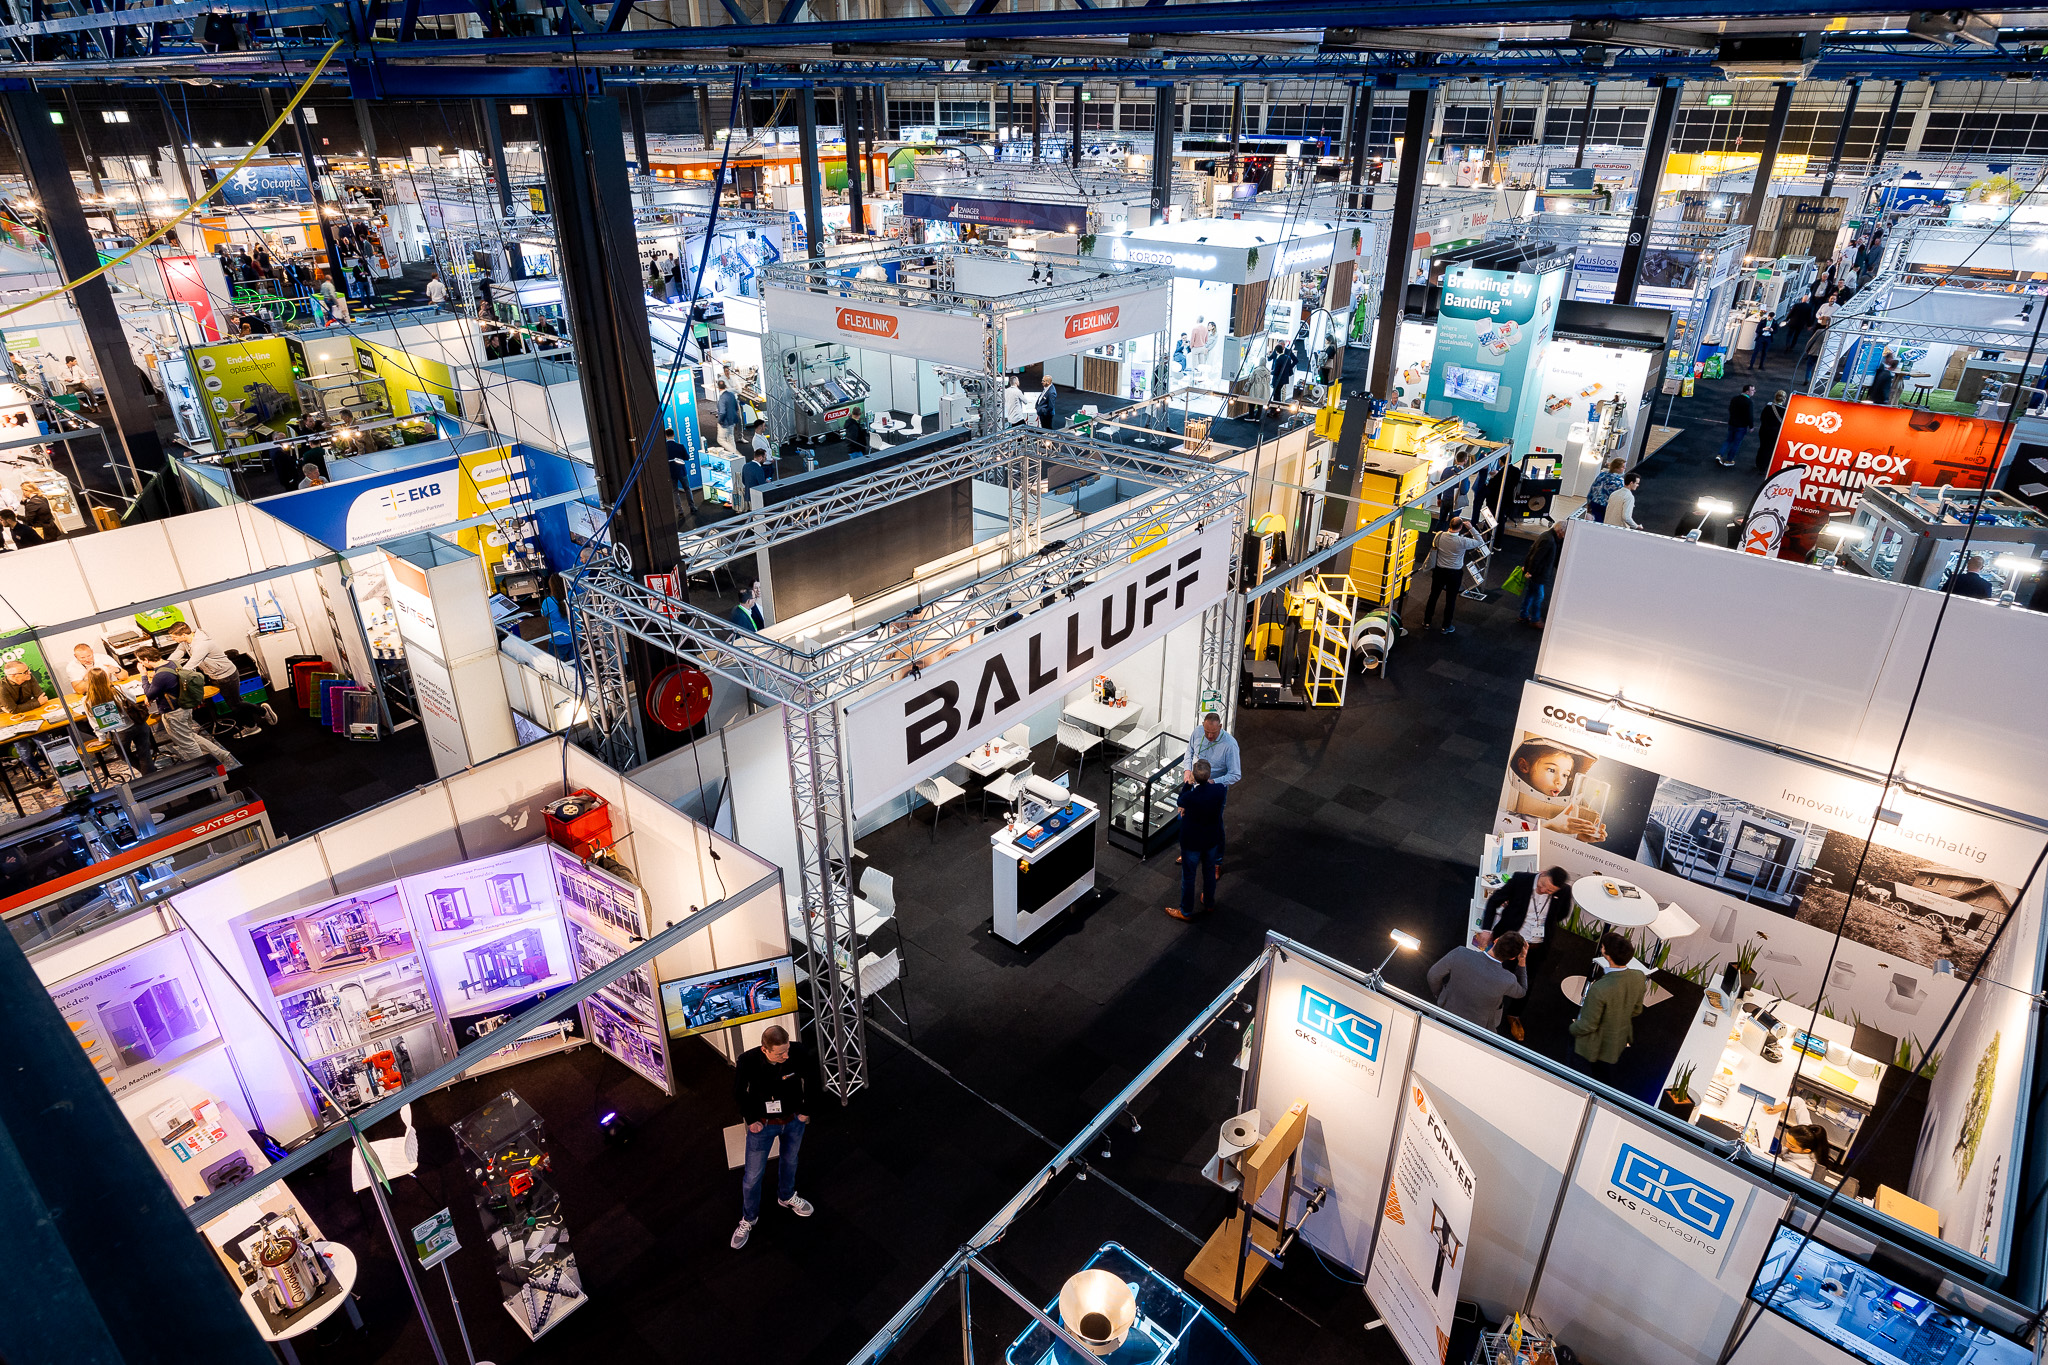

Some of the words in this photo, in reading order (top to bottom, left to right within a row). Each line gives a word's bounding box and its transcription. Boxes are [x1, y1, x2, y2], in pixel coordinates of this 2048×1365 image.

[261, 178, 301, 191] Octopus
[959, 206, 979, 215] ZWAGER
[1471, 211, 1489, 227] Weber
[1129, 250, 1173, 265] KOROZO
[1578, 254, 1618, 266] Ausloos
[1447, 273, 1510, 297] Branding
[1513, 279, 1533, 299] by
[844, 313, 889, 332] FLEXLINK
[1072, 313, 1112, 333] FLEXLINK
[1441, 324, 1458, 332] Where
[1438, 338, 1474, 349] sustainability
[1439, 332, 1457, 340] design
[226, 352, 271, 366] End-of-line
[229, 361, 277, 375] oplossingen
[827, 408, 848, 422] FLEXLINK
[684, 416, 695, 462] ingenious
[1787, 440, 1855, 467] YOUR
[1855, 452, 1912, 476] BOX
[690, 463, 697, 476] Be
[408, 482, 441, 502] EKB
[397, 508, 427, 520] Integration
[426, 502, 445, 512] Partner
[904, 547, 1202, 765] BALLUFF
[1541, 717, 1564, 729] DRUCK
[1633, 746, 1648, 756] 1833
[191, 809, 249, 835] BATEQ
[1781, 788, 1854, 821] Innovativ
[1893, 824, 1988, 864] nachhaltig
[52, 979, 94, 1001] Processing
[94, 964, 127, 983] Machine
[1301, 990, 1377, 1056] GKS
[1295, 1028, 1318, 1045] GKS
[1319, 1041, 1376, 1077] Packaging
[128, 1066, 162, 1087] Machines
[1427, 1114, 1473, 1196] FORMER
[1618, 1150, 1717, 1233] GKS
[1606, 1188, 1637, 1212] GKS
[1640, 1206, 1716, 1256] Packaging
